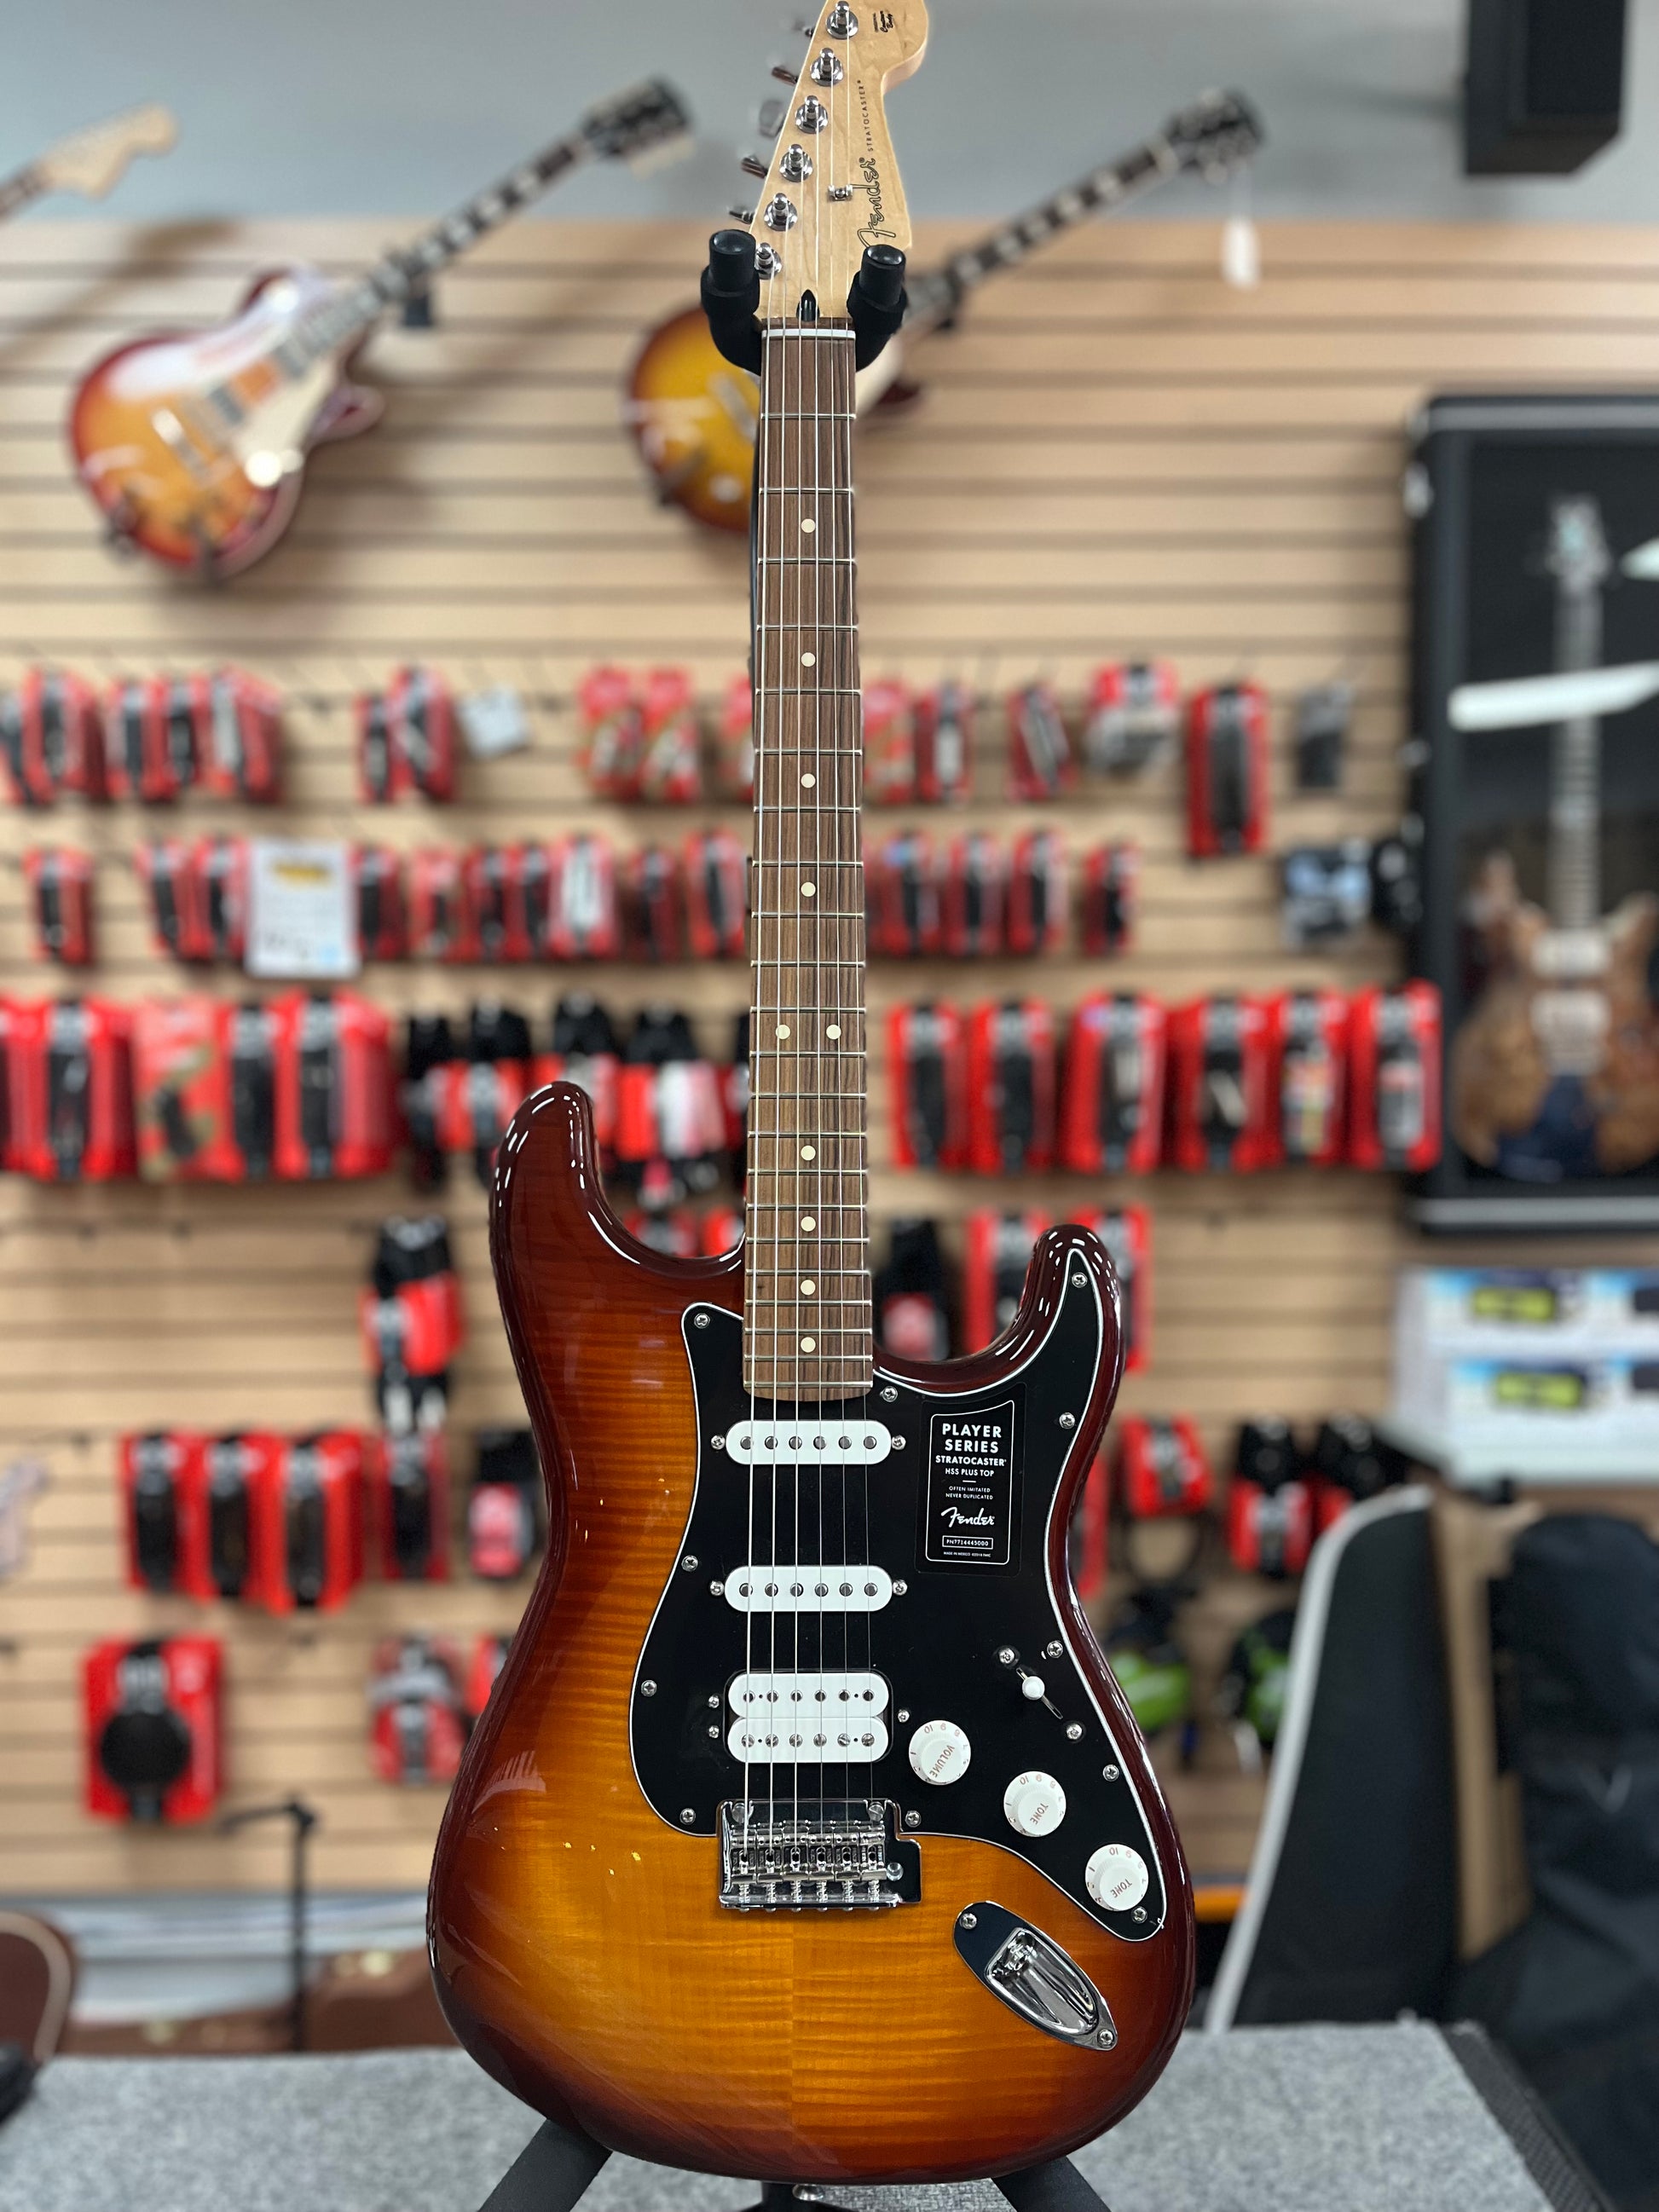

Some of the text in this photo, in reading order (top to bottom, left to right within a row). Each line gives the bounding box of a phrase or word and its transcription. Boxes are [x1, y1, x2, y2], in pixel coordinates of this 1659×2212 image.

[942, 1423, 1002, 1438] PLAYER
[945, 1439, 998, 1453] SERIES
[929, 1745, 955, 1778] VOLUME
[1030, 1803, 1049, 1825] TONE
[1110, 1879, 1132, 1898] TONE
